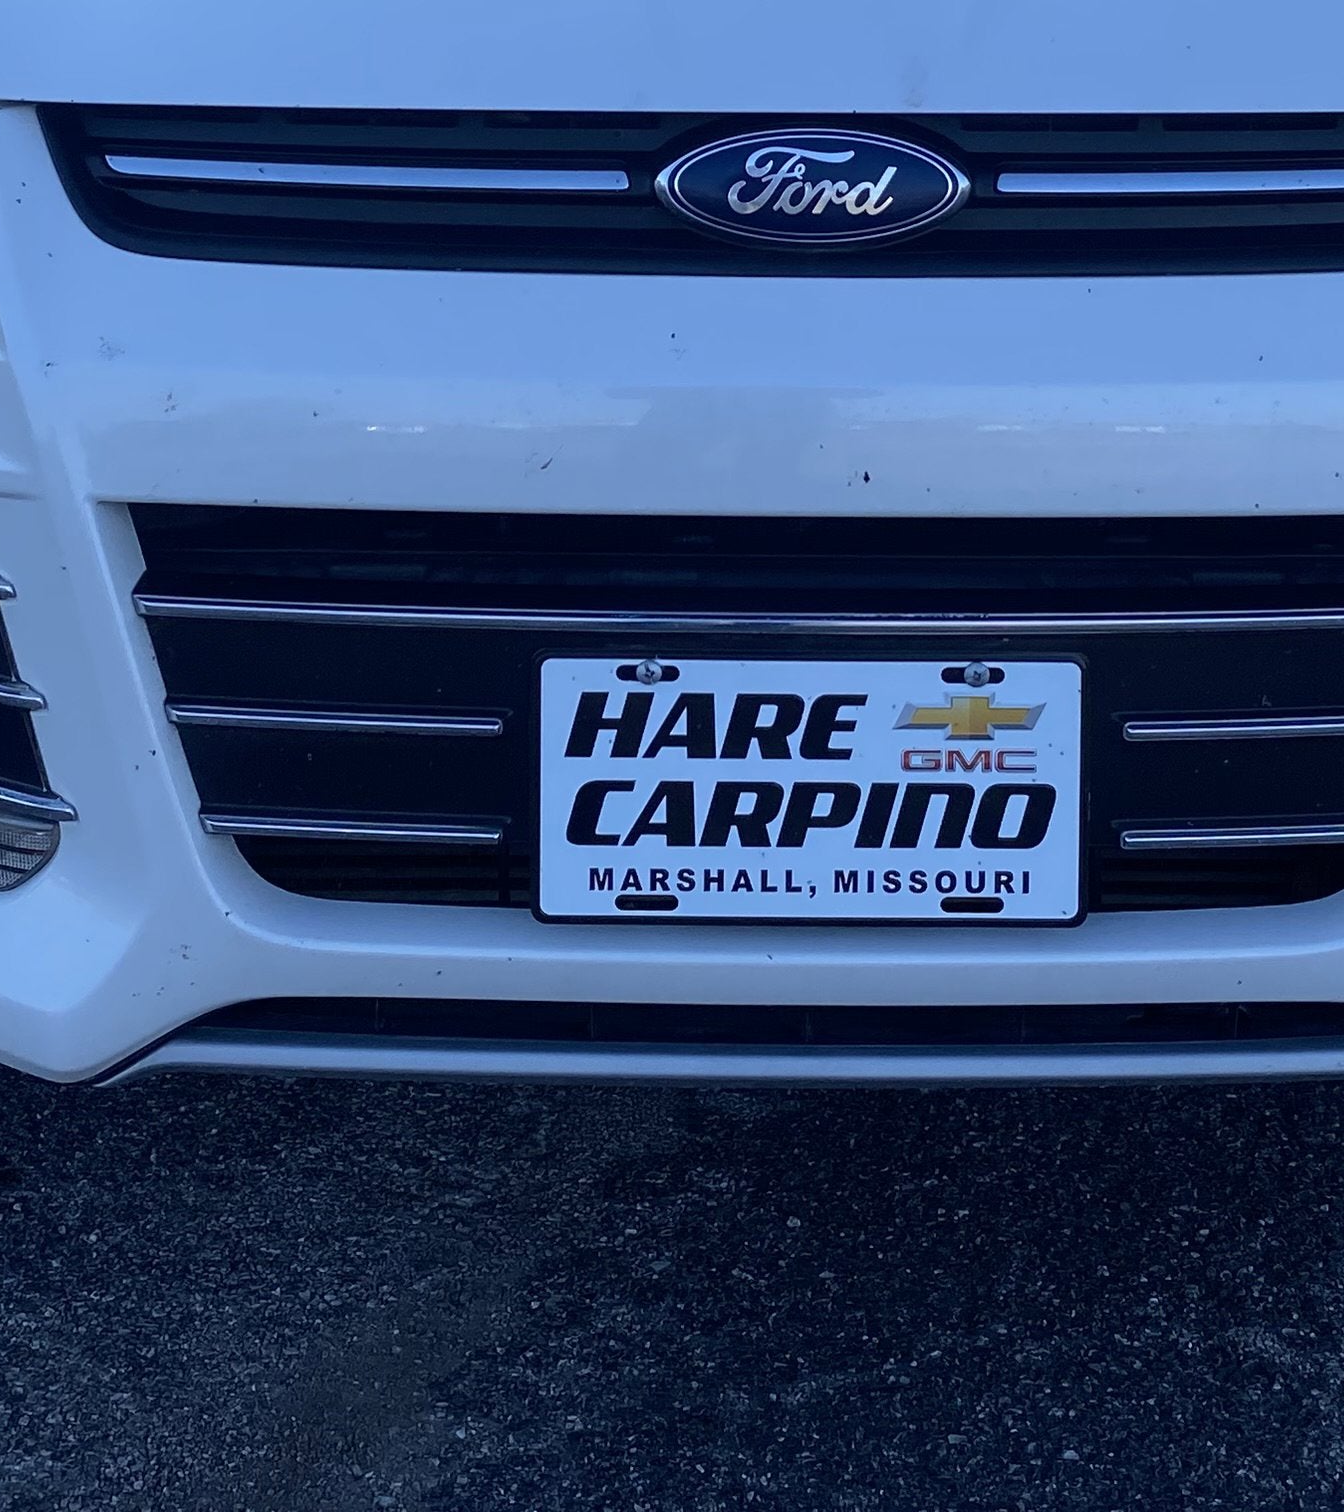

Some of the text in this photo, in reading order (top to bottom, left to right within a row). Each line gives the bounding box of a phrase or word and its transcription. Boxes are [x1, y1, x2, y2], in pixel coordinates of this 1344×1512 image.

[727, 146, 898, 216] Ford
[564, 691, 869, 760] HARE
[899, 748, 1038, 773] GMC
[566, 779, 1057, 849] CARPINO
[588, 867, 1032, 899] MARSHALL, MISSOURI
